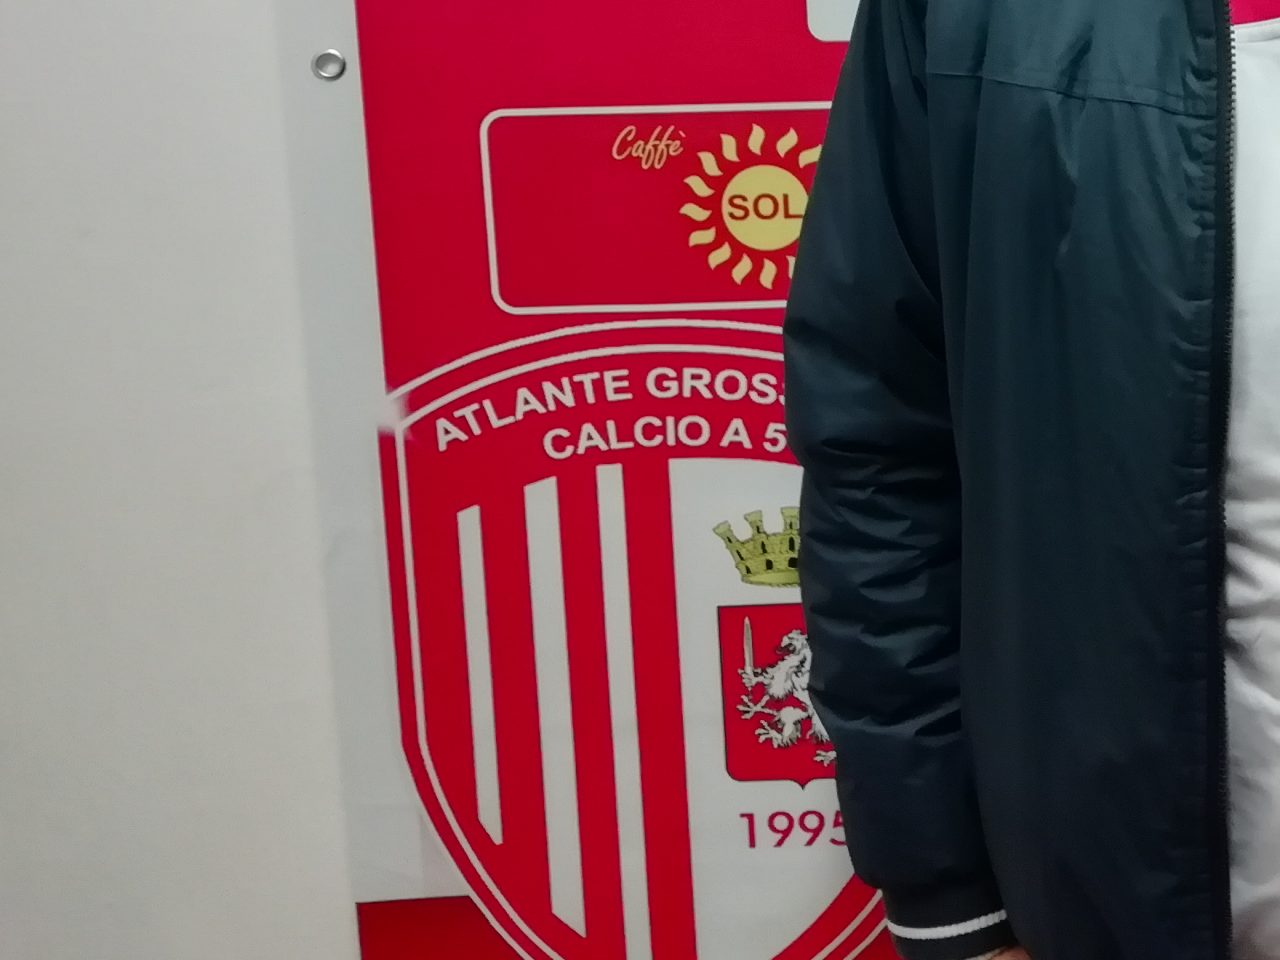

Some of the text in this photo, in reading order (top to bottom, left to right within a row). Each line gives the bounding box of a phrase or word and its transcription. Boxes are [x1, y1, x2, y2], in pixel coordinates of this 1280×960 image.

[611, 125, 687, 170] Caffè
[727, 193, 804, 221] SOL
[434, 367, 785, 452] ATLANTE GROS
[543, 415, 787, 460] CALCIO A 5
